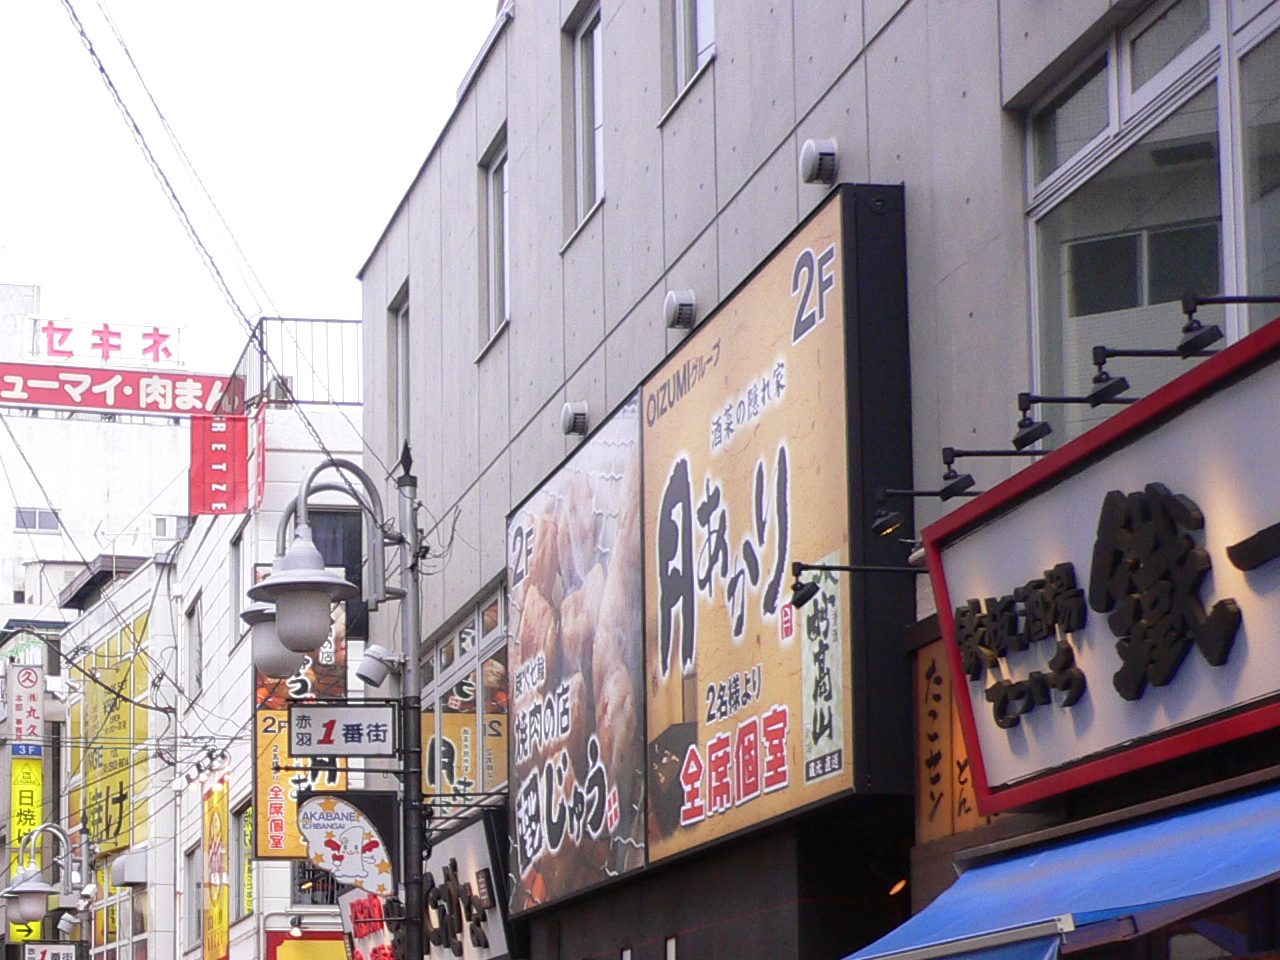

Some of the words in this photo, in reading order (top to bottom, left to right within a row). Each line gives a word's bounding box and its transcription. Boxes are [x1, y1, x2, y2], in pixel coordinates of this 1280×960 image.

[789, 245, 835, 345] 2F
[41, 320, 172, 363] セキネ
[511, 524, 534, 588] 2F
[656, 446, 790, 677] 月あかり
[515, 684, 571, 765] 焼肉の店
[705, 664, 763, 723] 2名様より
[19, 746, 36, 756] 3F
[679, 703, 789, 827] 全席個室
[302, 811, 356, 822] AKABANE
